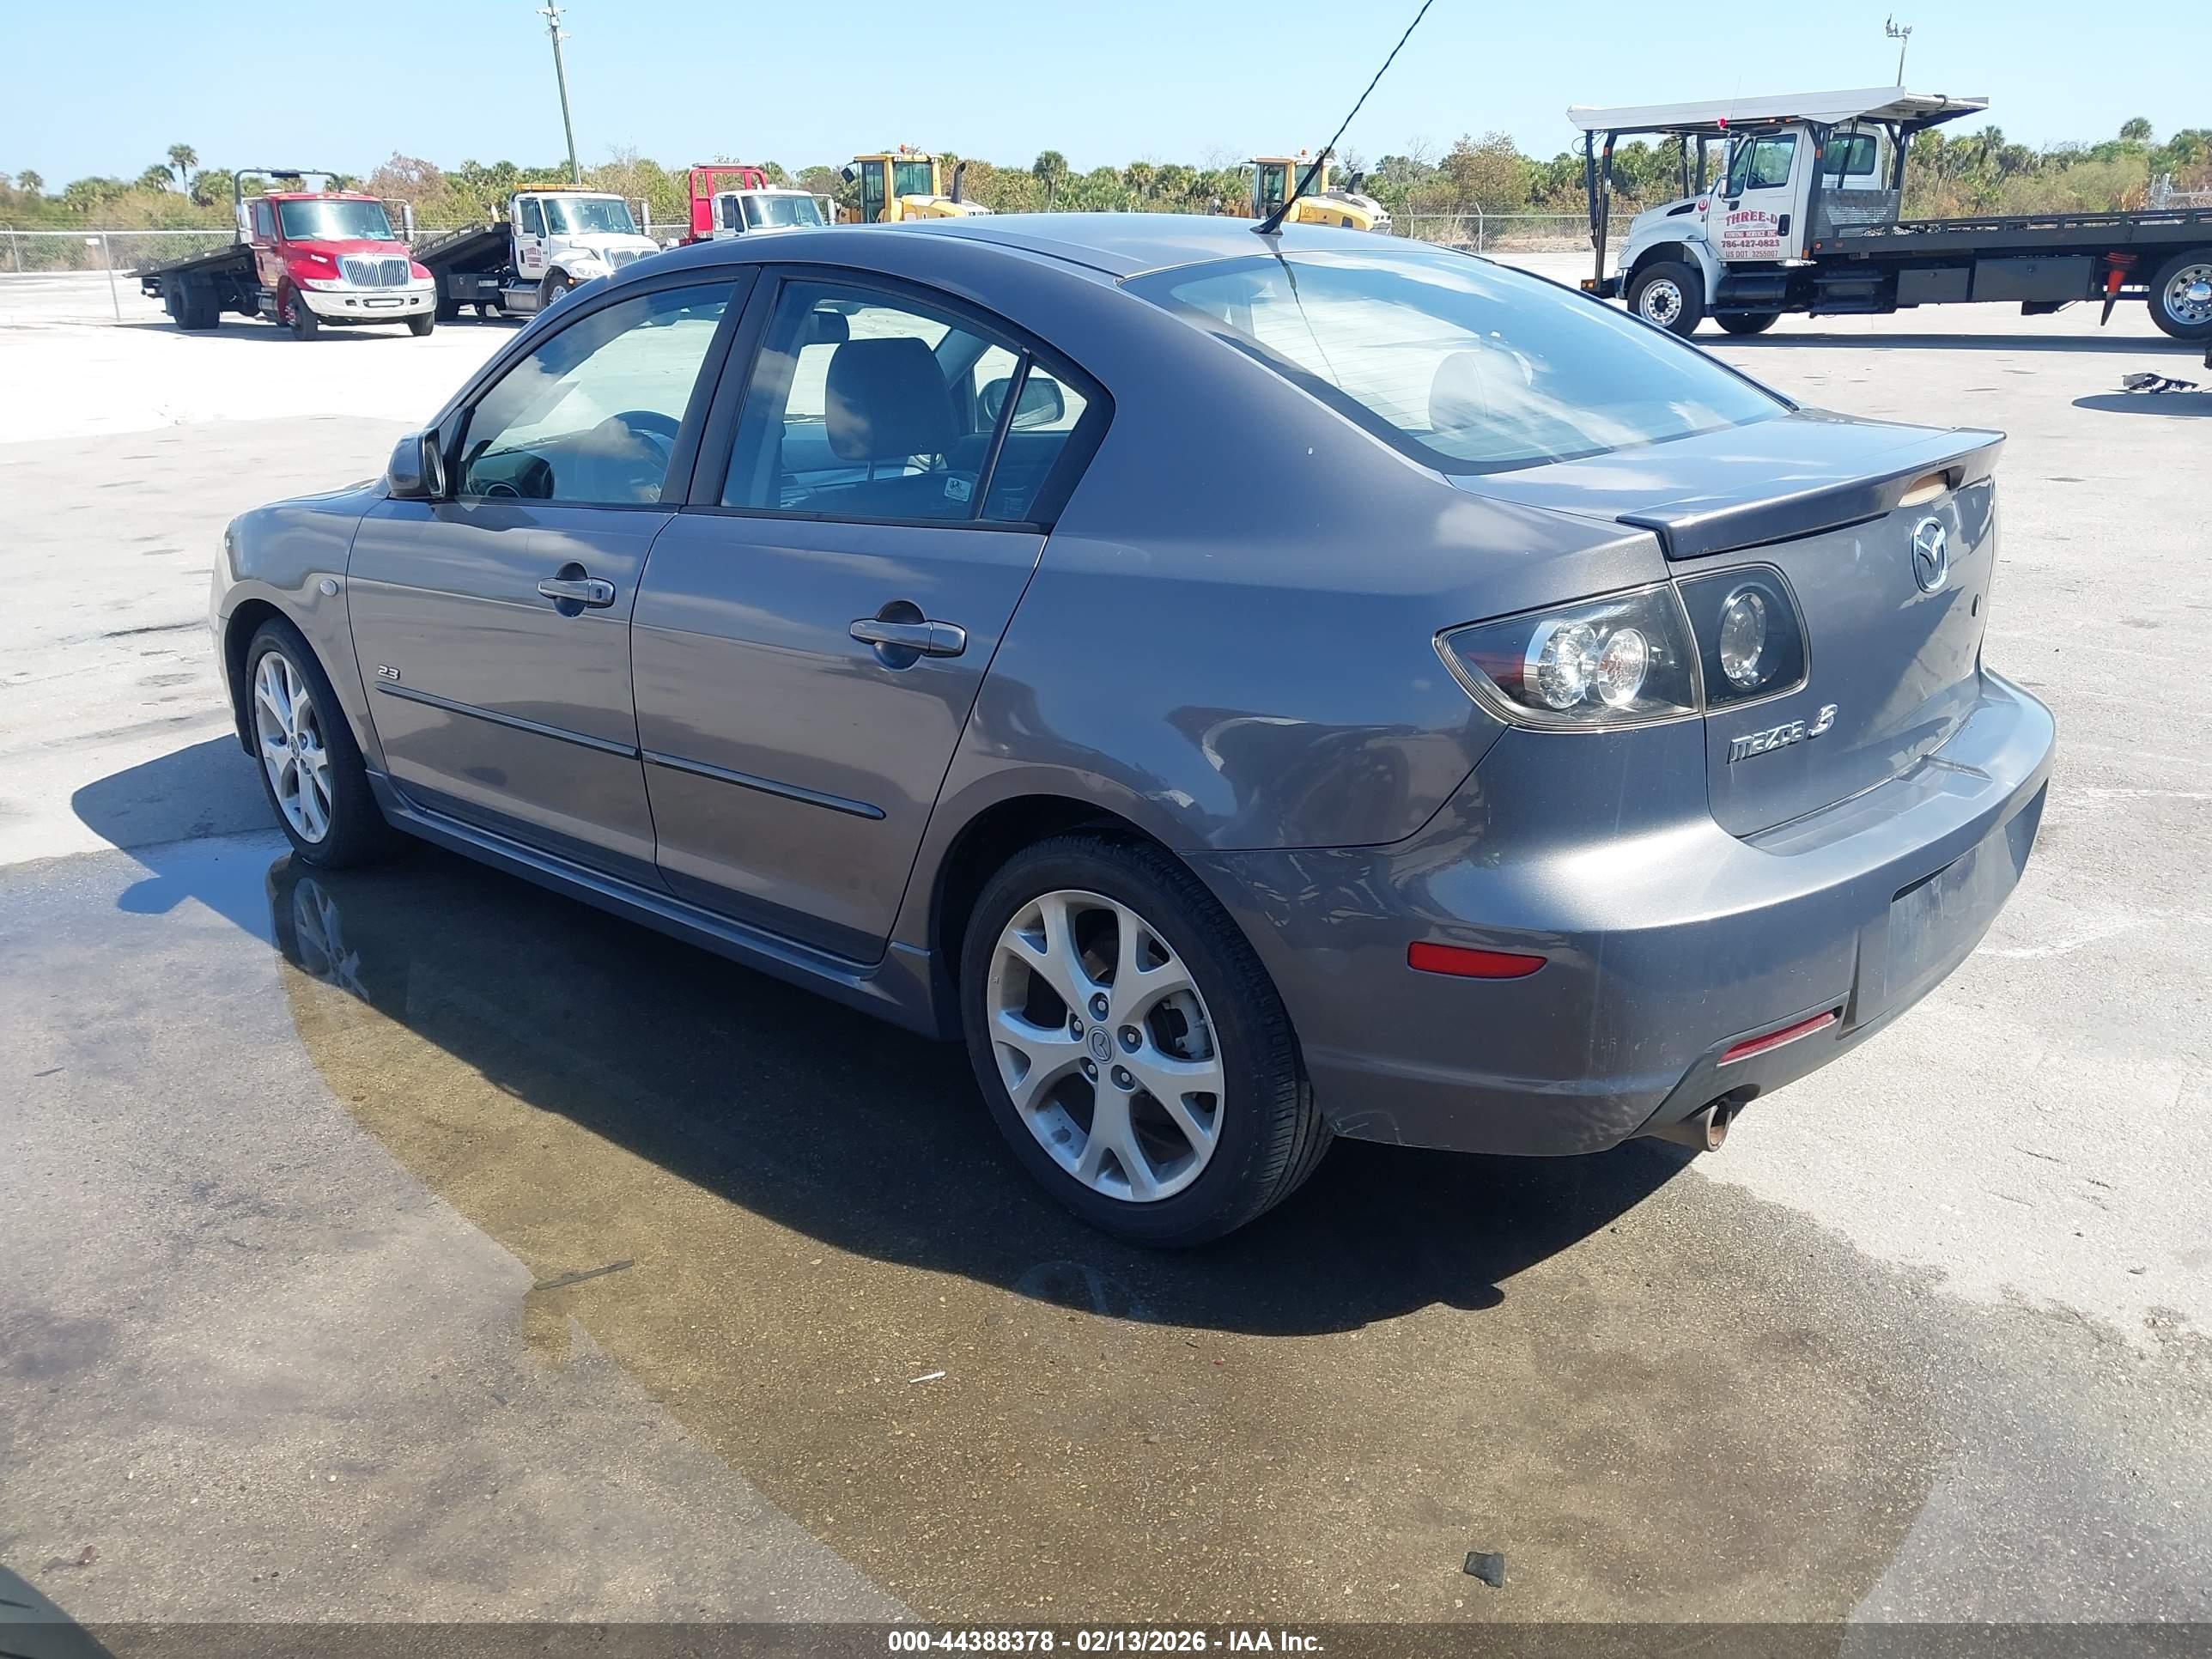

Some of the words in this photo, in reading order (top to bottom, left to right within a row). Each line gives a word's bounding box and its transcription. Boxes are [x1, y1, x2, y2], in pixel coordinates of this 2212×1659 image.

[1725, 210, 1778, 227] THREE-D
[1721, 239, 1780, 248] 786-427-0823
[1807, 703, 1838, 738] 3
